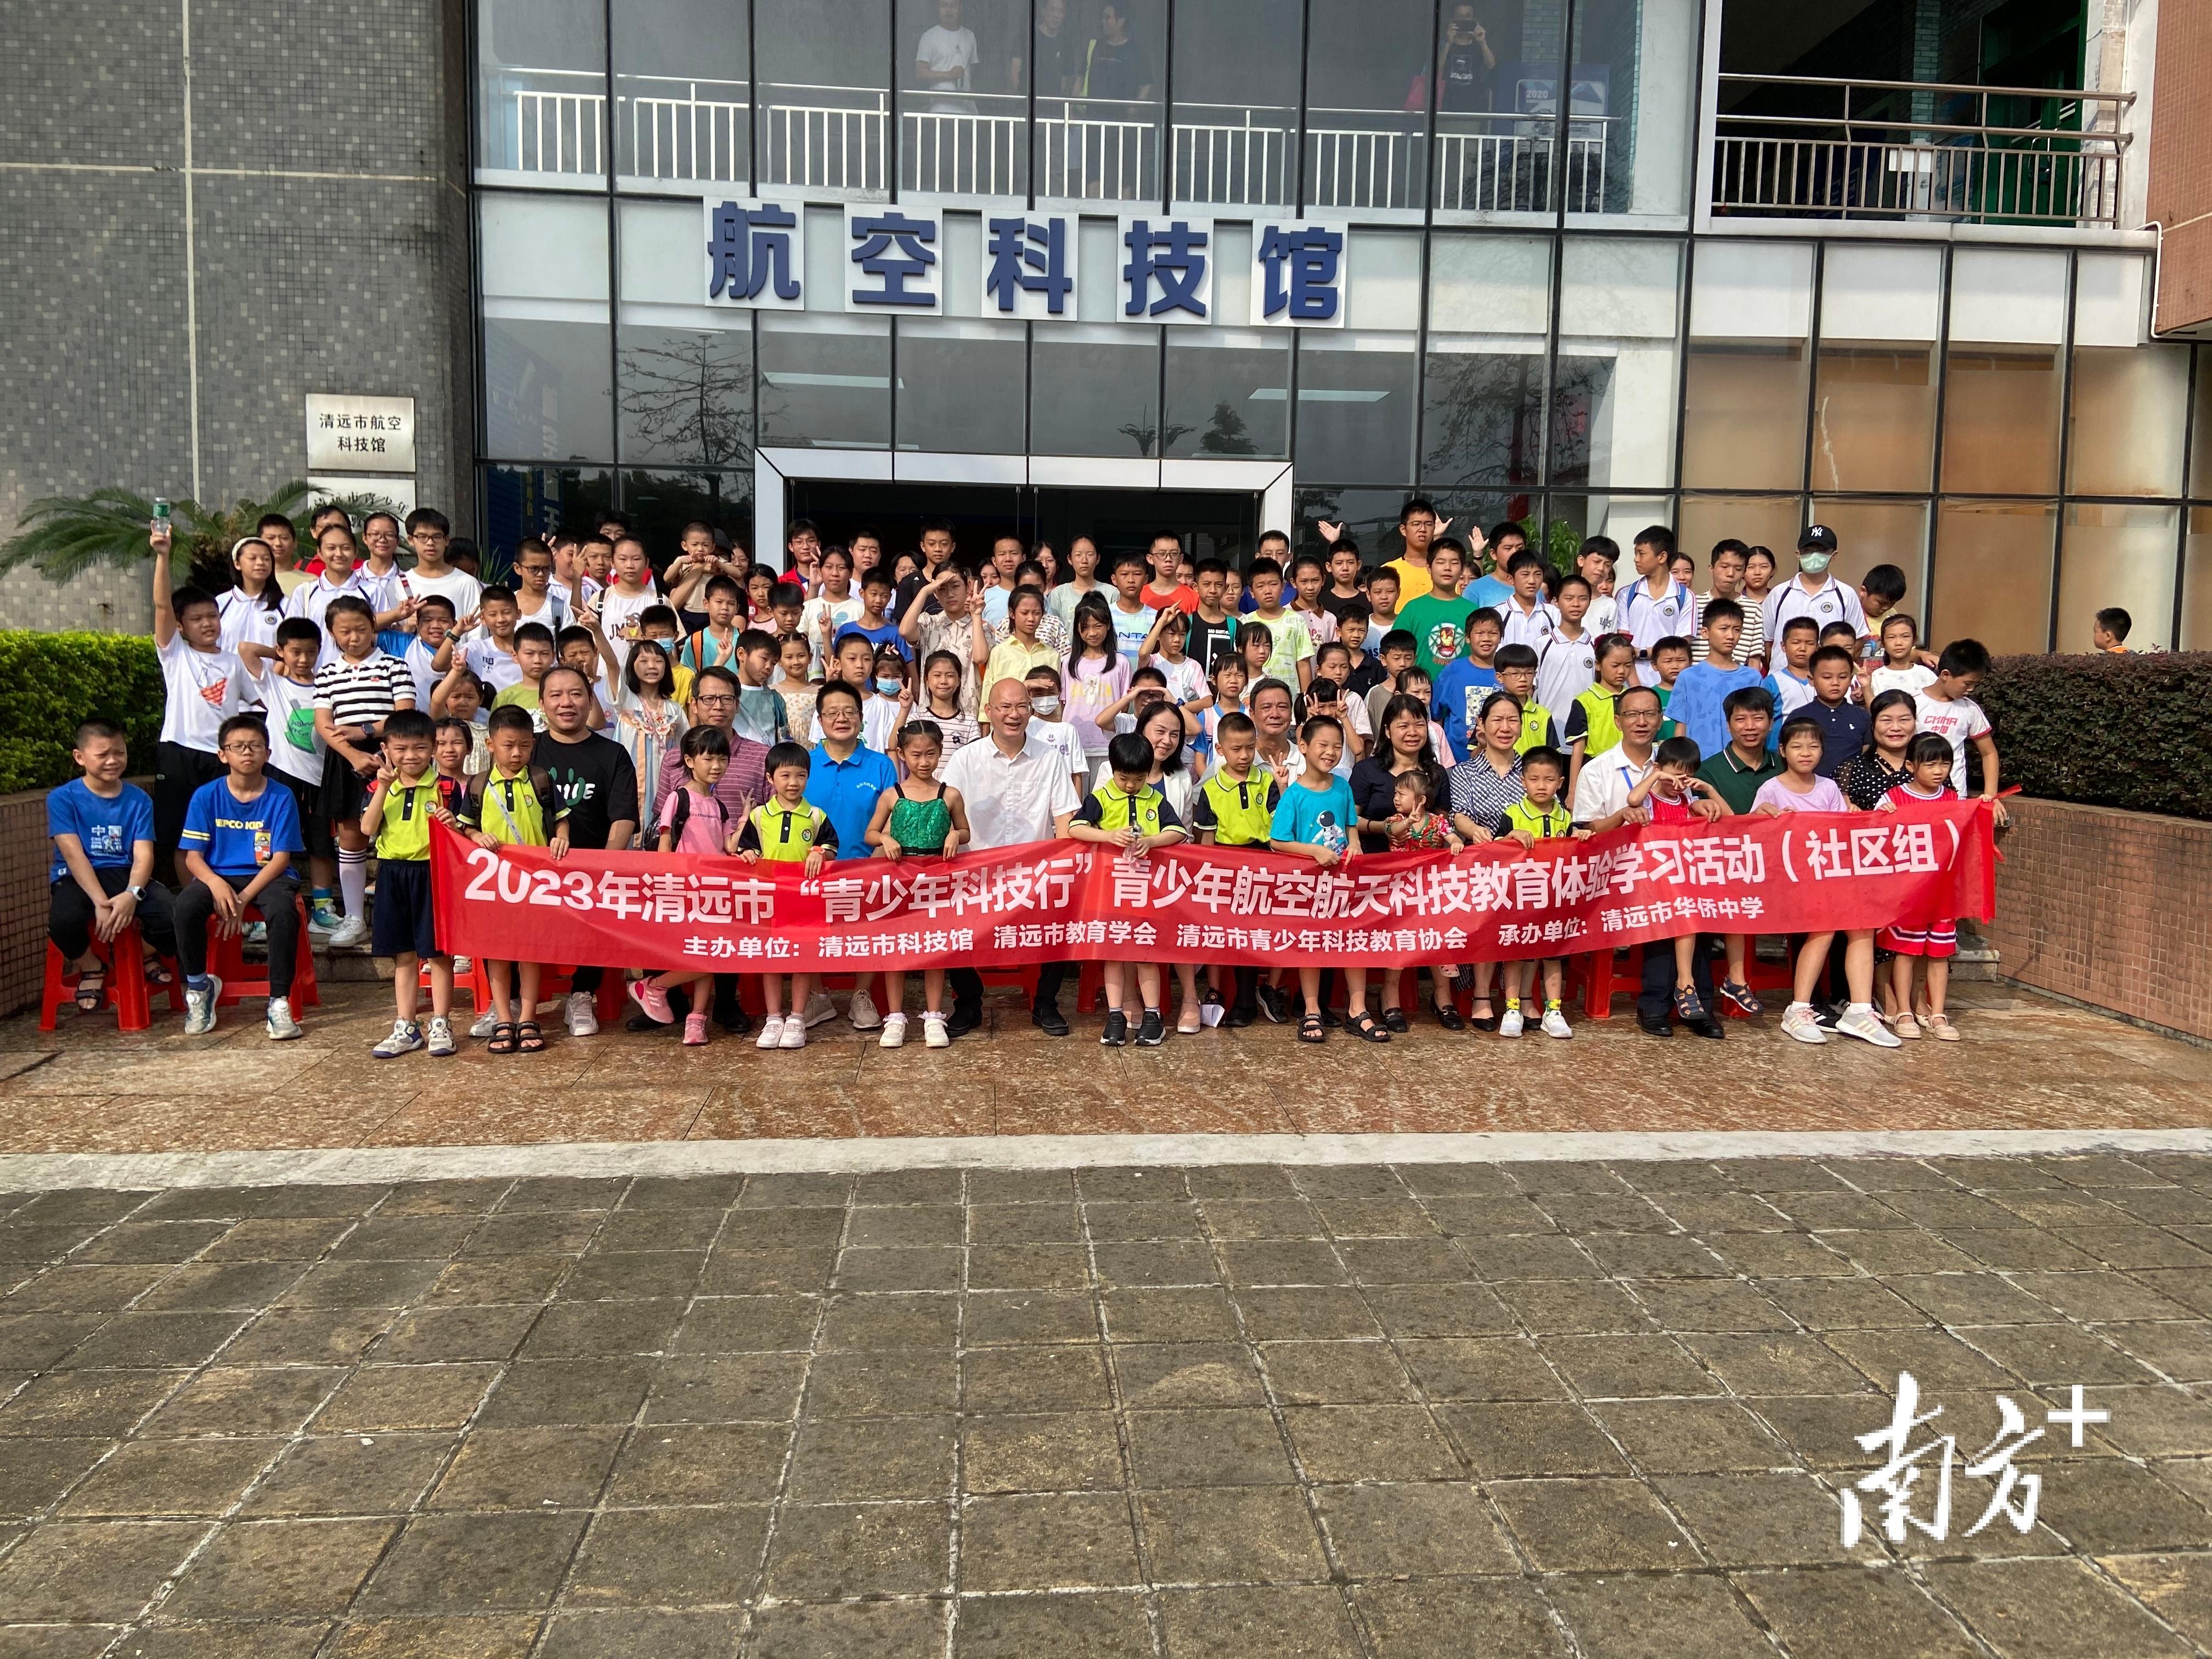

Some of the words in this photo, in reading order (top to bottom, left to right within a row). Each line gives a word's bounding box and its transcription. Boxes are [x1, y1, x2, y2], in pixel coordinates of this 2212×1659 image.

[1526, 90, 1548, 99] 2020
[707, 200, 1343, 319] 航空科技馆
[319, 413, 401, 431] 清远市航空
[337, 436, 386, 453] 科技馆
[1116, 631, 1149, 640] NTA
[1924, 715, 1958, 726] CHINA
[994, 919, 1158, 949] 清远市教育学会
[1177, 923, 1468, 953] 清远市青少年科技教育协会
